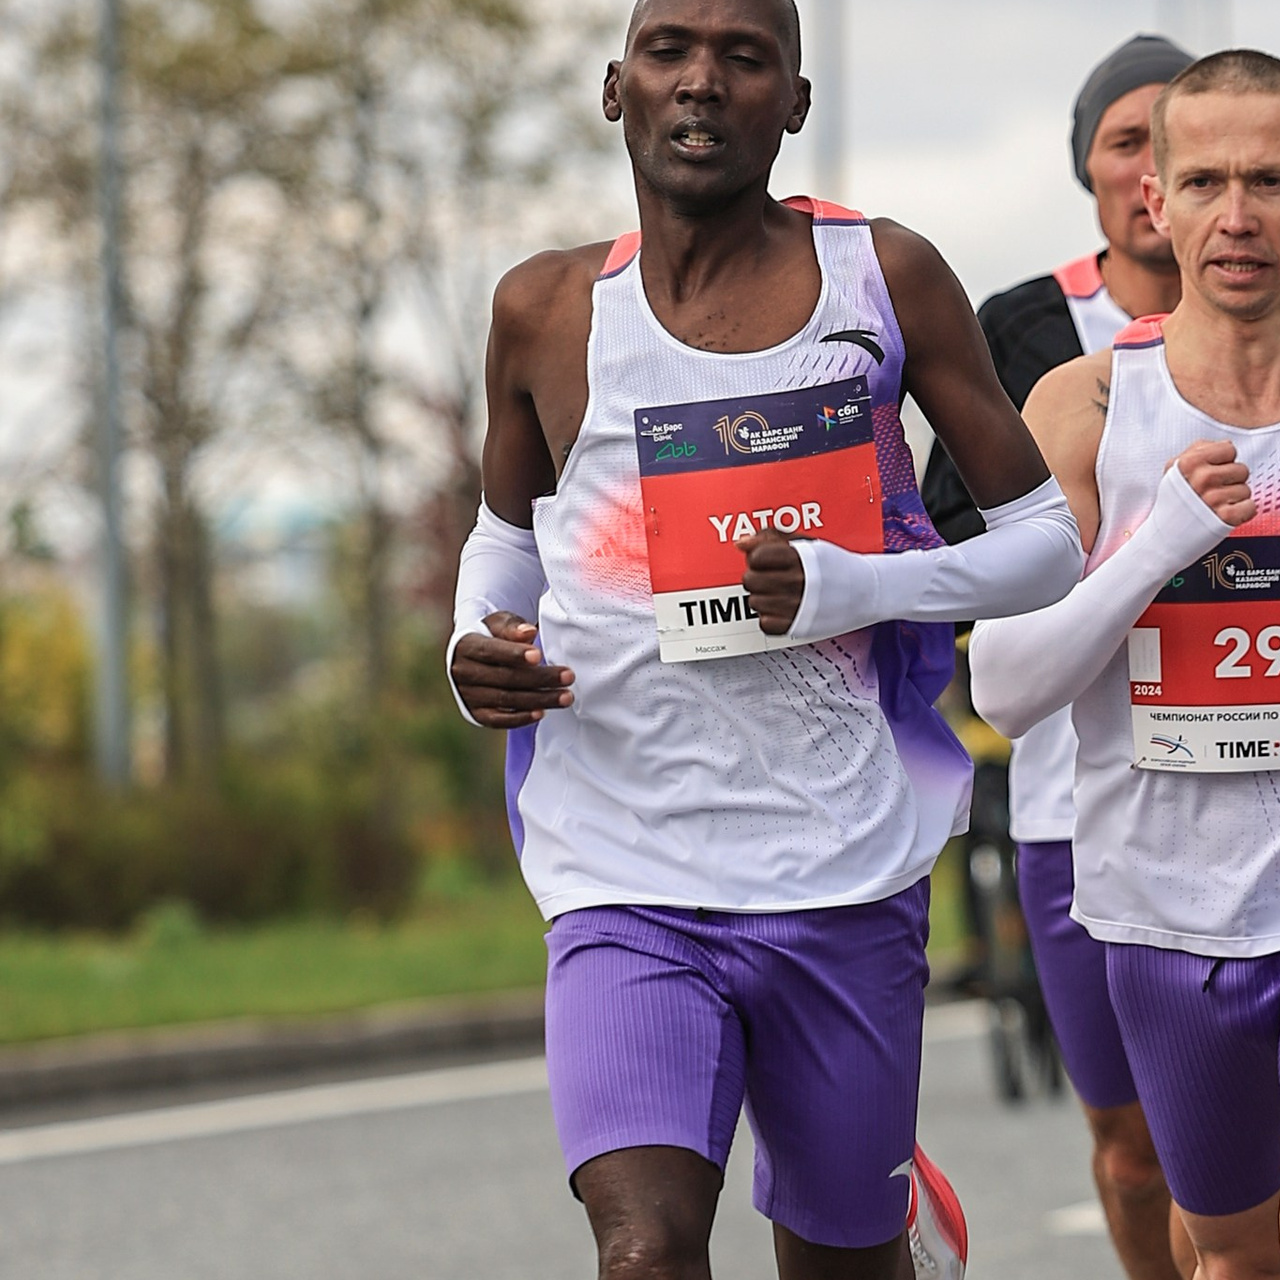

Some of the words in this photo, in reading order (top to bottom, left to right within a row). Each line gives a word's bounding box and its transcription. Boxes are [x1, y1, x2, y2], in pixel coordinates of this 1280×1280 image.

[750, 431, 761, 439] АК
[762, 428, 782, 438] БАРС
[783, 425, 804, 434] БАНК
[750, 432, 799, 446] КАЗАНСКИЙ
[751, 442, 790, 453] МАРАФОН
[708, 502, 824, 543] YATOR
[1134, 684, 1163, 696] 2024
[1150, 712, 1214, 722] ЧЕМПИОНАТ
[1216, 712, 1261, 722] РОССИИ
[1263, 711, 1279, 720] ПО
